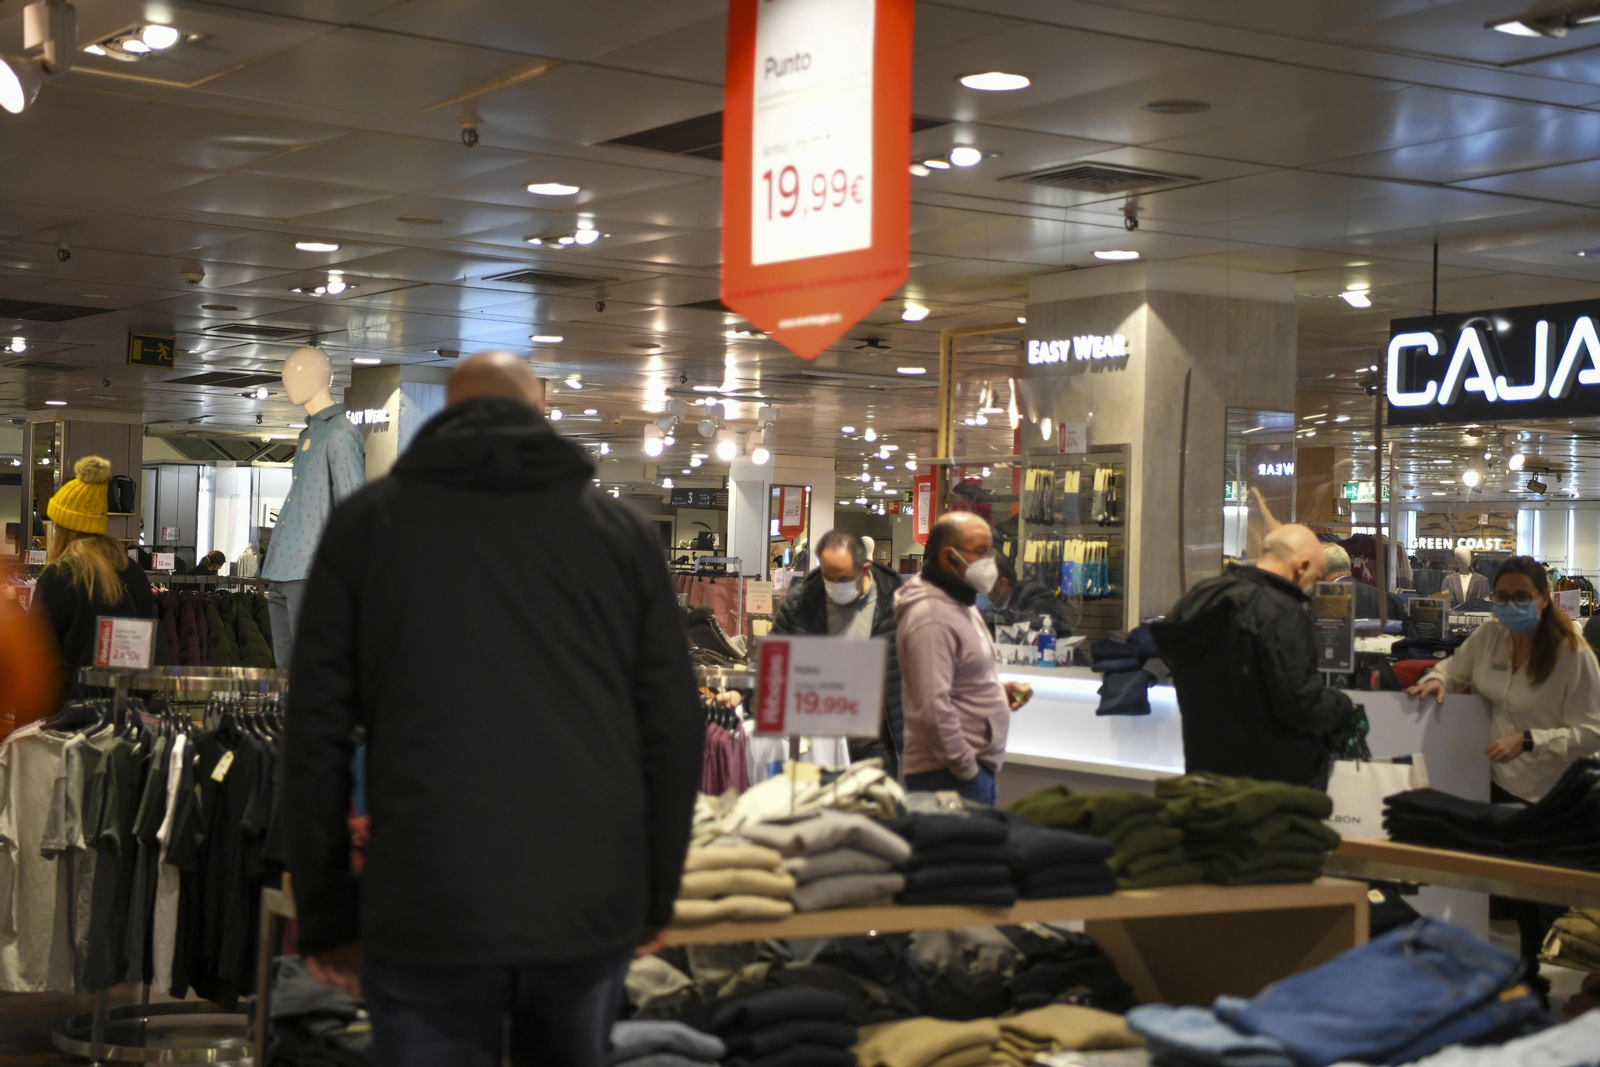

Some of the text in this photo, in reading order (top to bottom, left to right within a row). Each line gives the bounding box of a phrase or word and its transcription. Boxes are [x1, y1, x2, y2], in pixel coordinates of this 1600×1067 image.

[764, 51, 812, 80] Punto
[762, 164, 864, 220] 19,99€
[1028, 334, 1126, 365] EASY WEAR
[1387, 316, 1600, 407] CAJA
[687, 492, 693, 504] 3
[1408, 537, 1503, 550] GREEN COAST
[795, 690, 860, 716] 19,99€
